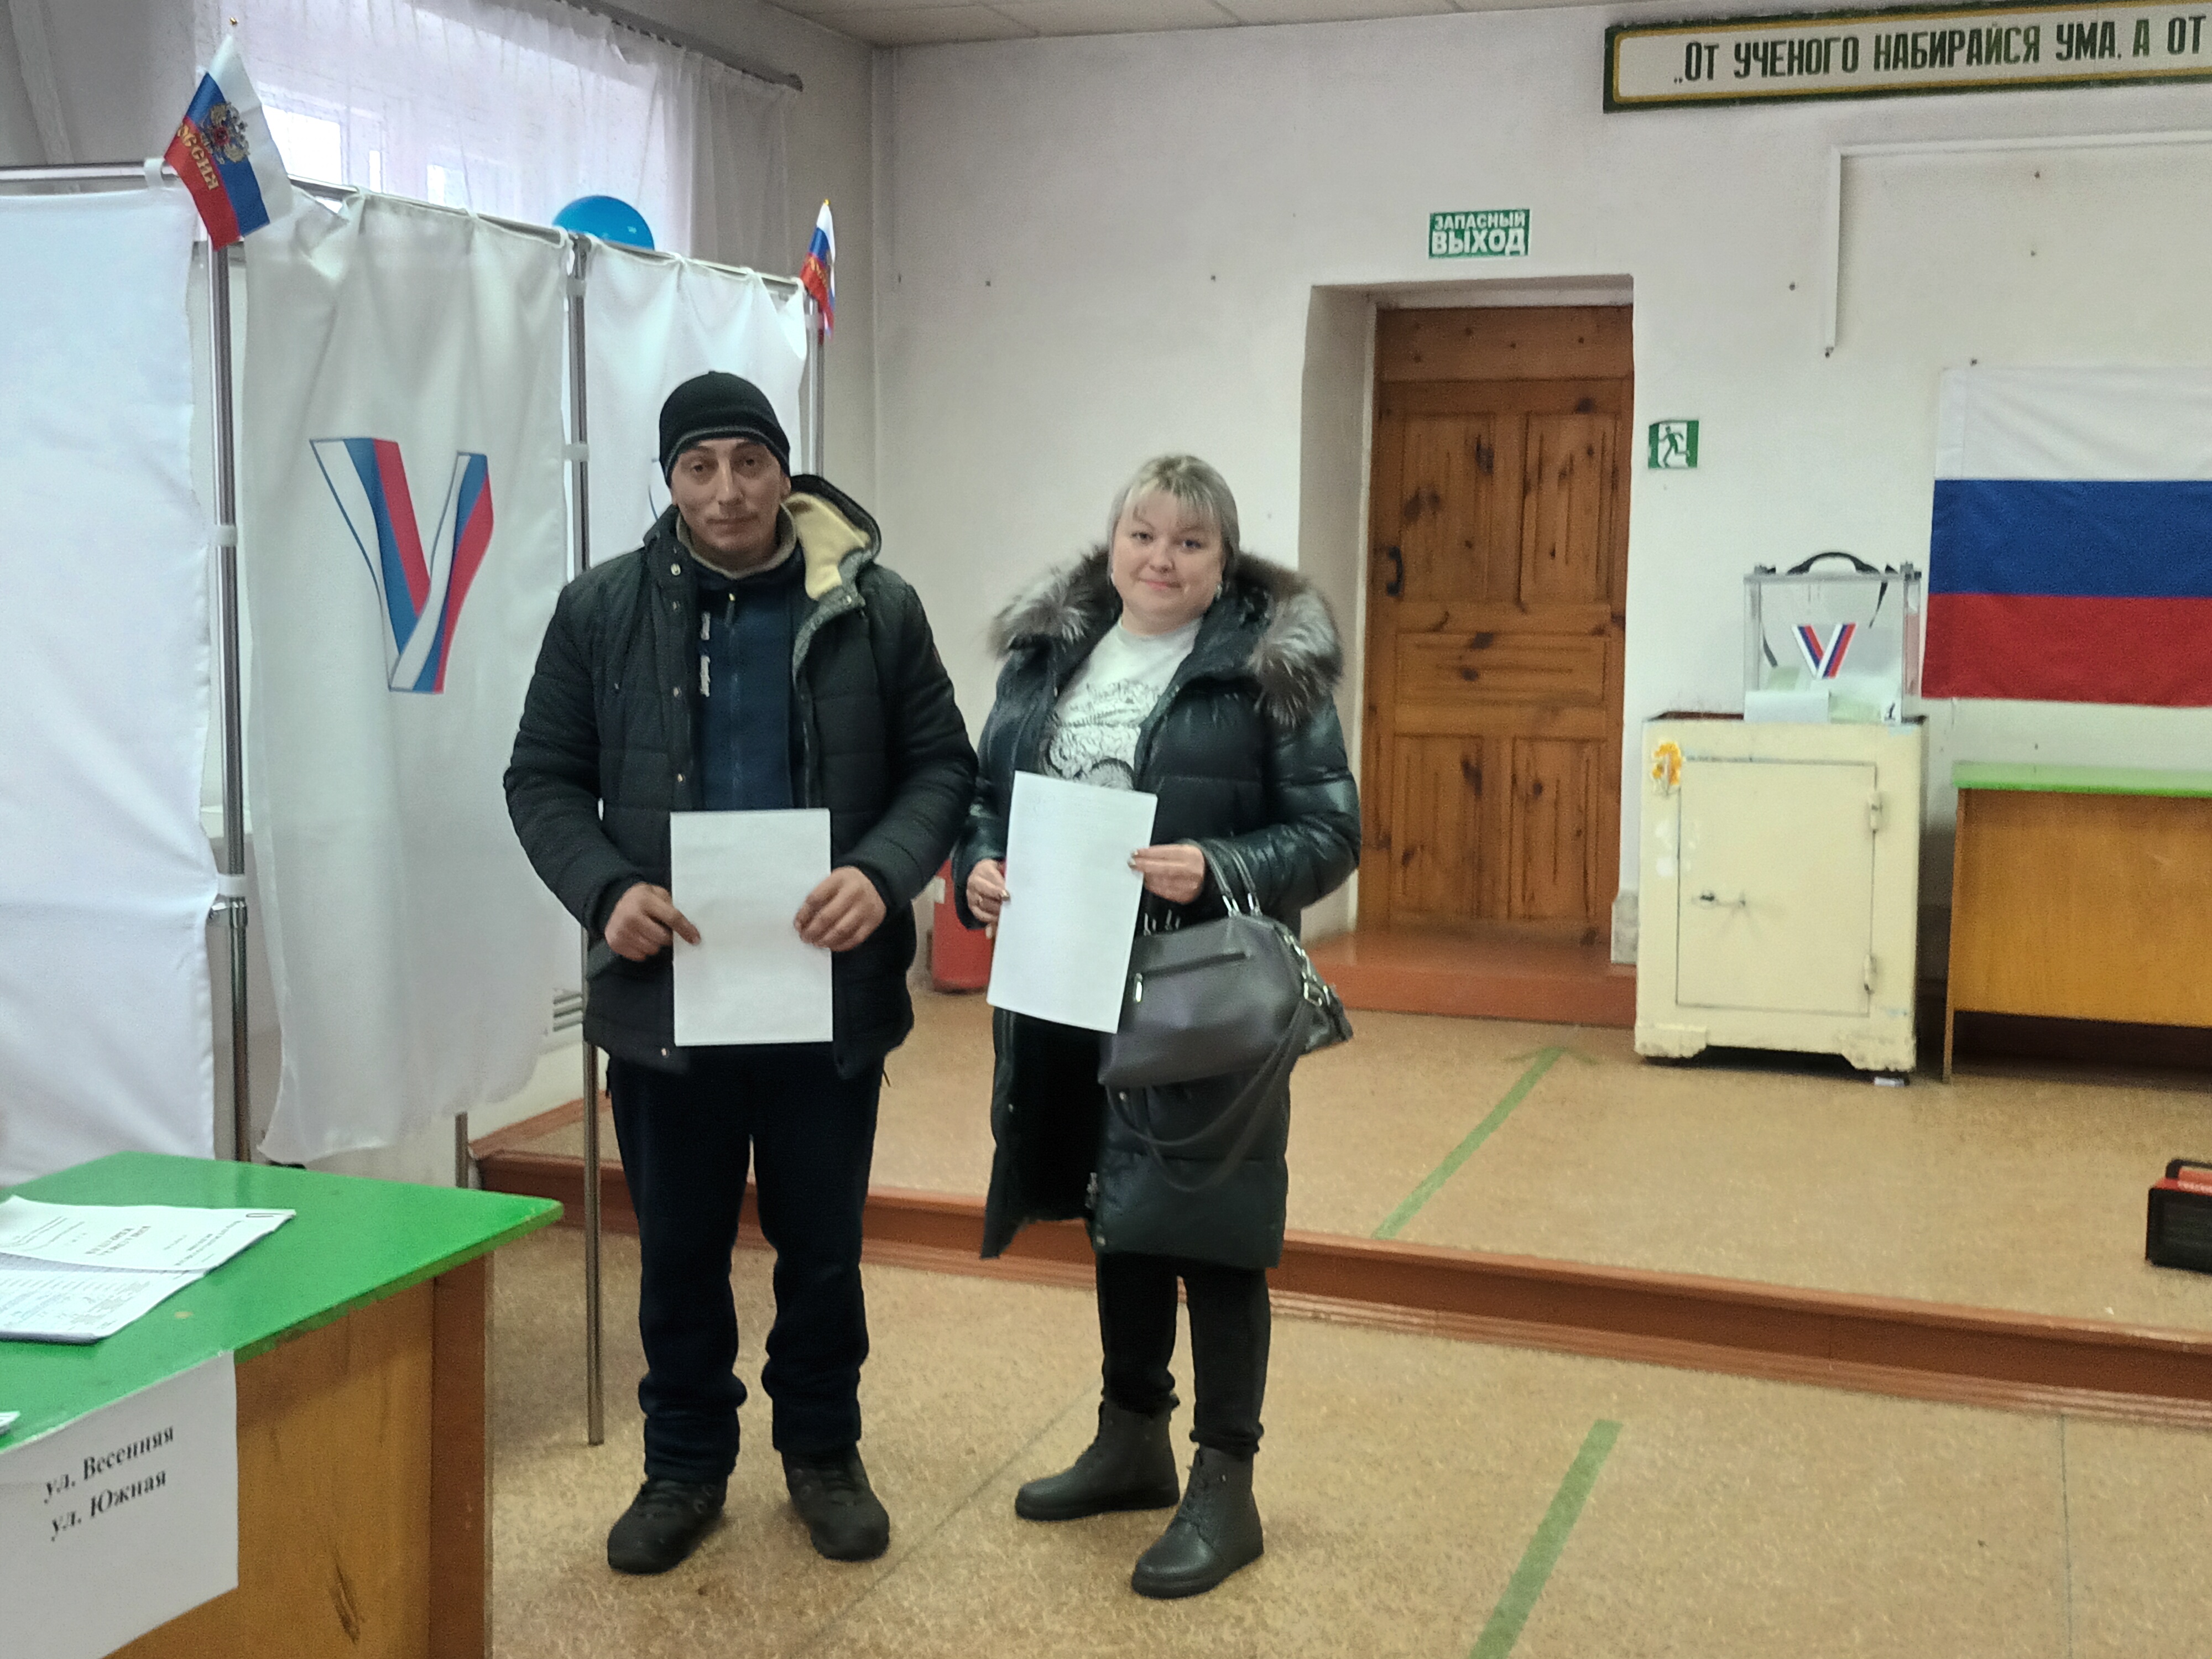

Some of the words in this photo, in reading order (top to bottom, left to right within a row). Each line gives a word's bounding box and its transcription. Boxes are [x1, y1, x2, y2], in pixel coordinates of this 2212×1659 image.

[1734, 36, 1859, 79] УЧЕНОГО
[1874, 22, 2040, 71] НАБИРАЙСЯ
[2132, 18, 2150, 57] А
[2167, 15, 2206, 54] ОТ
[1432, 227, 1526, 256] ВЫХОД
[1434, 212, 1525, 230] ЗАПАСНЫЙ
[44, 1473, 76, 1504] ул.
[83, 1425, 174, 1480] Весенняя
[51, 1511, 82, 1542] ул.
[90, 1469, 167, 1518] Южная
